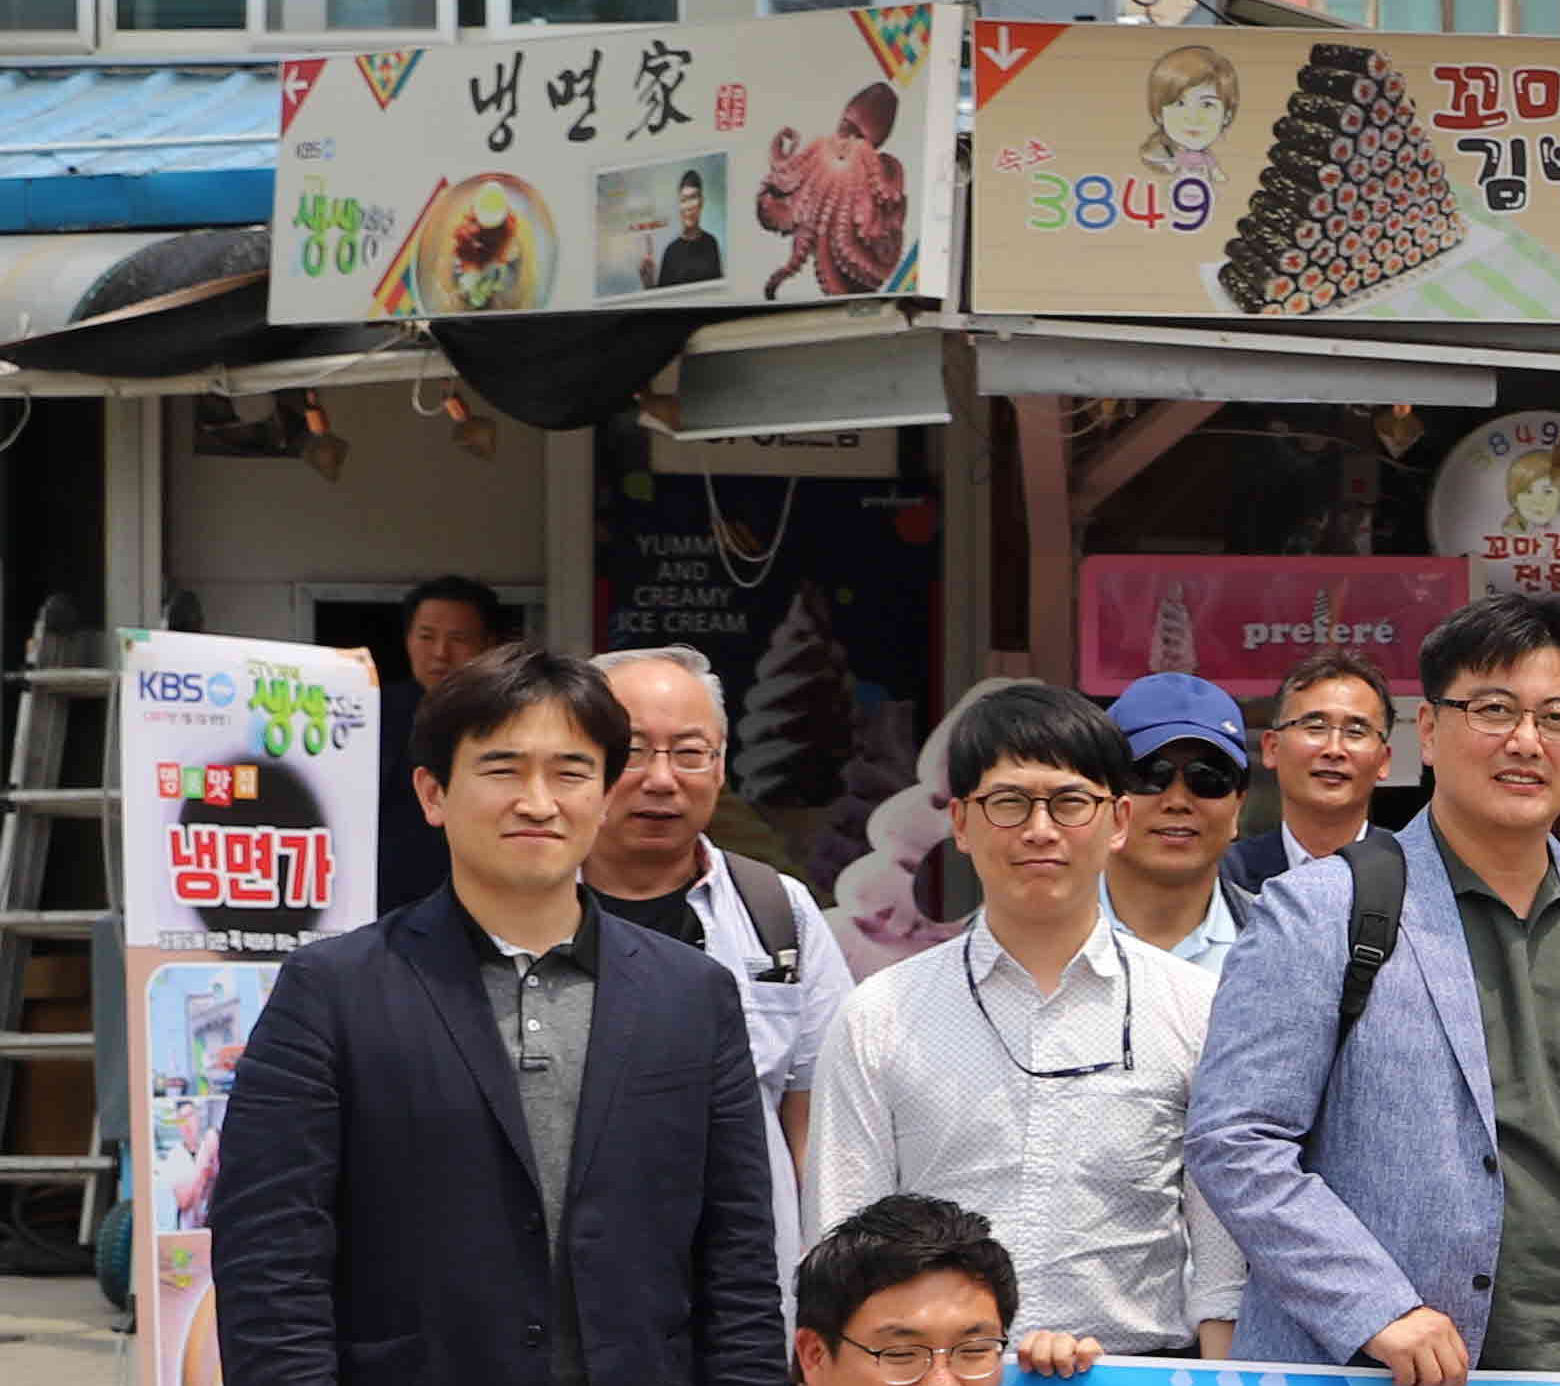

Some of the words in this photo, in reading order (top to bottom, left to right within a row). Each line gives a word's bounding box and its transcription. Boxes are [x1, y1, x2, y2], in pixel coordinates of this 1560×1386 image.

[993, 140, 1057, 172] 속초
[1030, 173, 1212, 231] 3849
[658, 562, 709, 581] AND
[633, 587, 731, 607] CREAMY
[663, 612, 748, 633] CREAM
[1242, 617, 1393, 649] preferé
[139, 671, 203, 702] KBS
[169, 829, 332, 903] 냉면가
